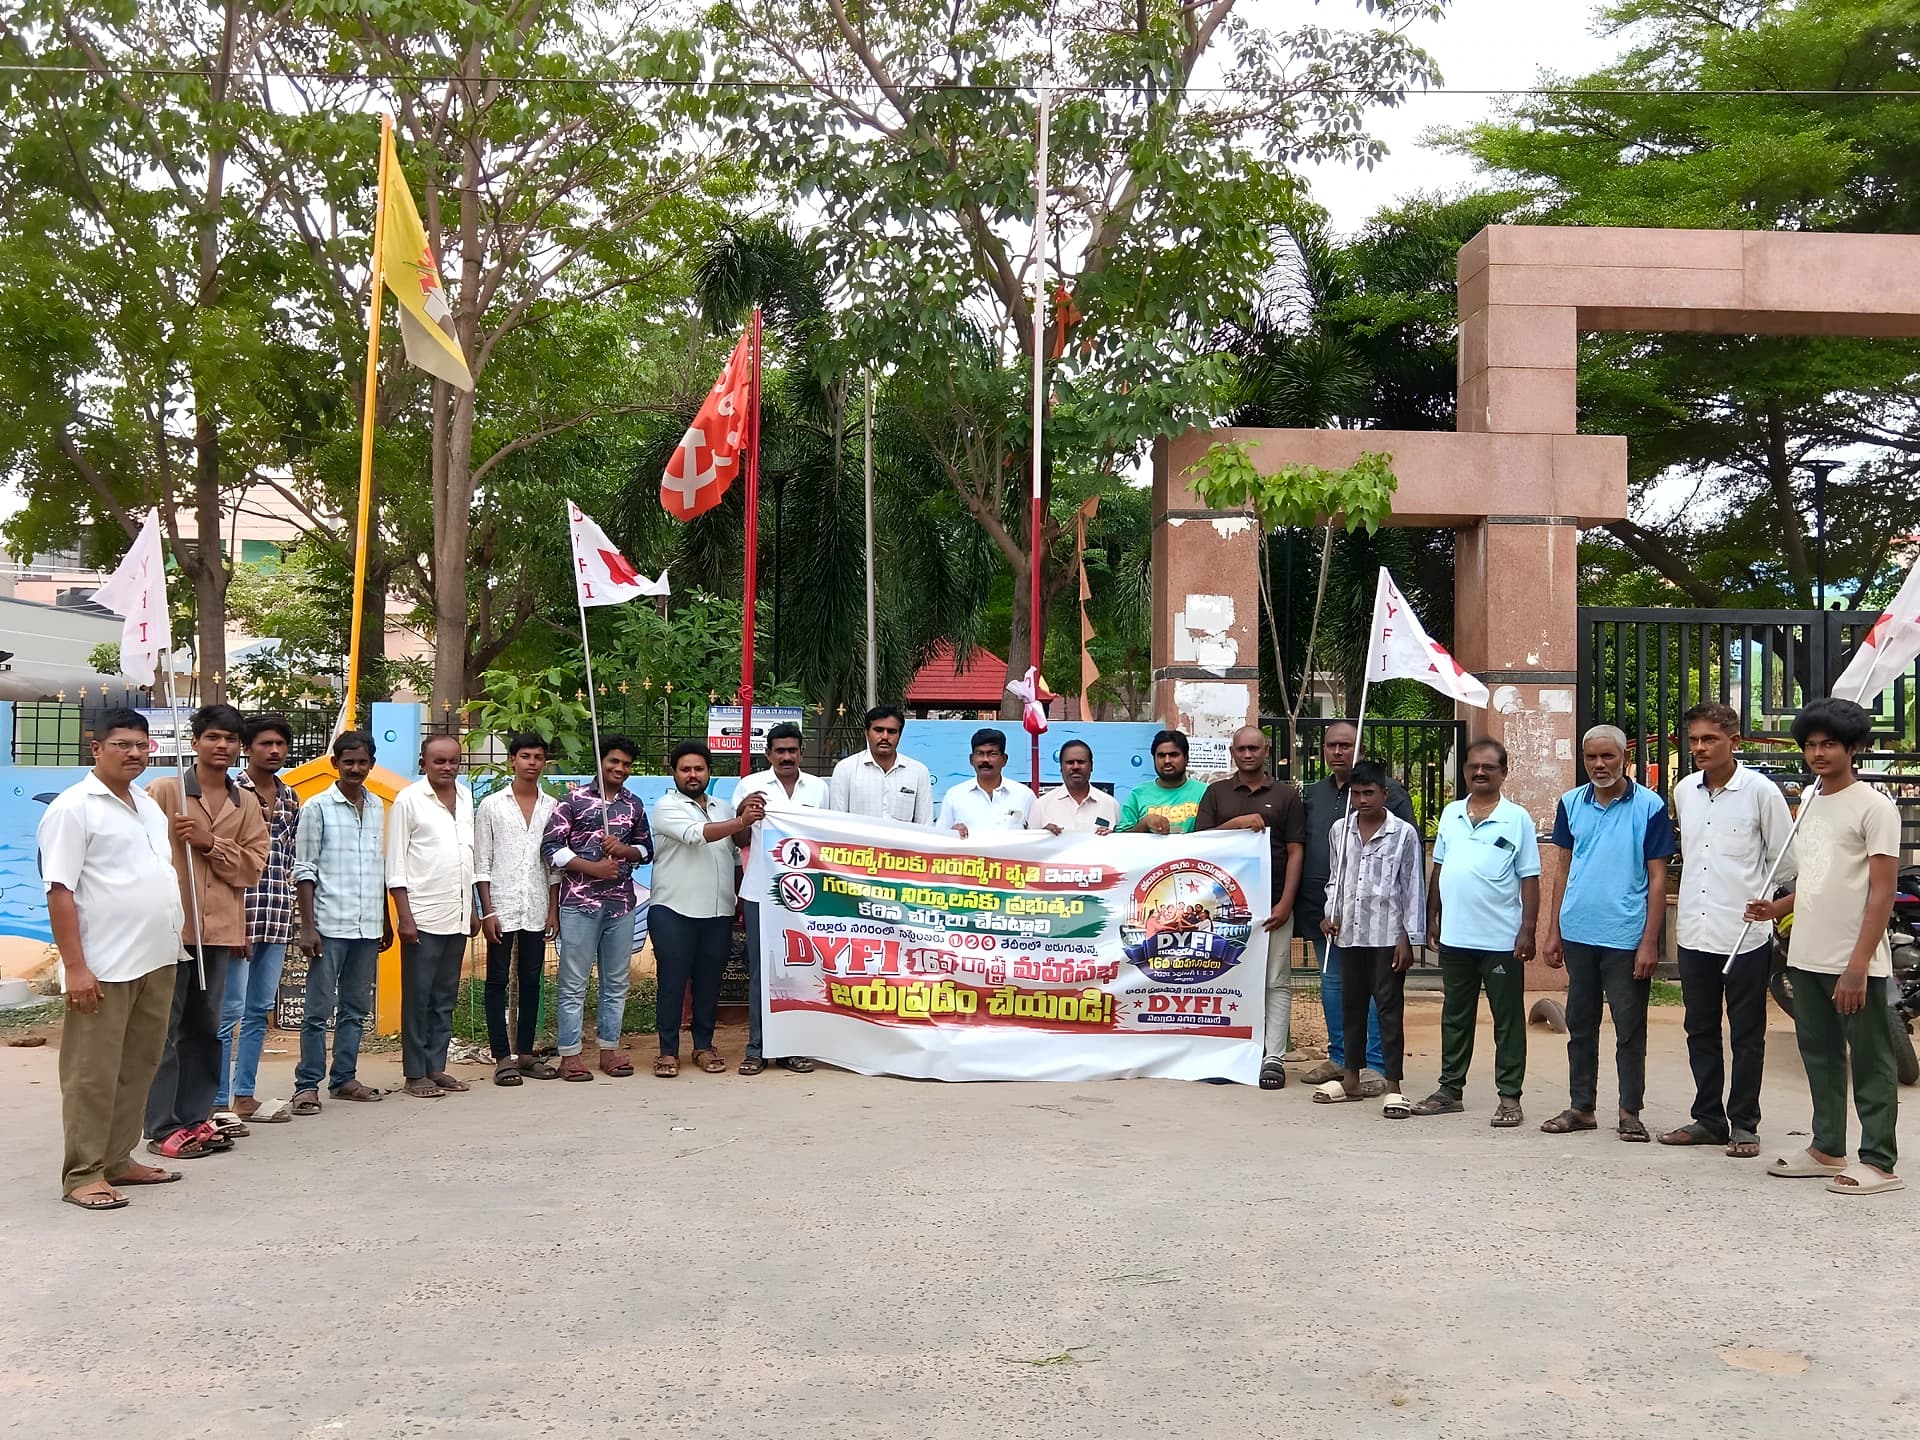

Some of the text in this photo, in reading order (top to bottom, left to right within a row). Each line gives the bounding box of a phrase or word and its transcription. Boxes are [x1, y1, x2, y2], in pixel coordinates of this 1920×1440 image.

[819, 846, 928, 875] నిరుద్యోగులకు
[931, 857, 1002, 885] నిరుద్యోగ
[901, 887, 1001, 911] నిర్మూలనకు
[1005, 894, 1085, 919] ప్రభుత్వం
[784, 928, 903, 975] DYFI
[1157, 931, 1214, 952] DYFI
[1147, 994, 1223, 1015] DYFI
